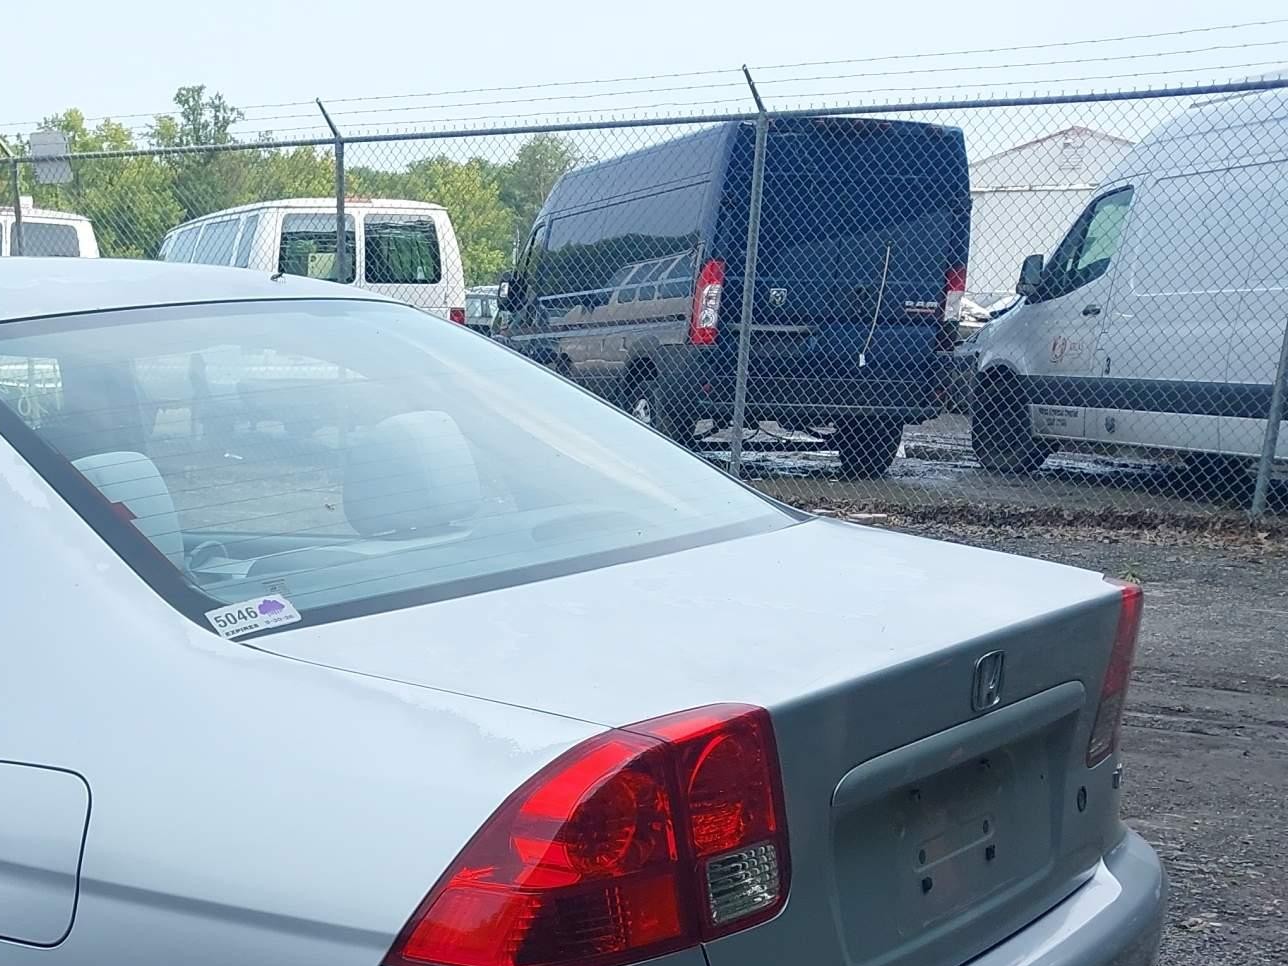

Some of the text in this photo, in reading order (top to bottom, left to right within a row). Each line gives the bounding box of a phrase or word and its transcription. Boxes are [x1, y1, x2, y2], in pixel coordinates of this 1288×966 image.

[904, 300, 938, 308] RAM
[213, 606, 259, 629] 5046
[224, 622, 260, 637] EXPIRES
